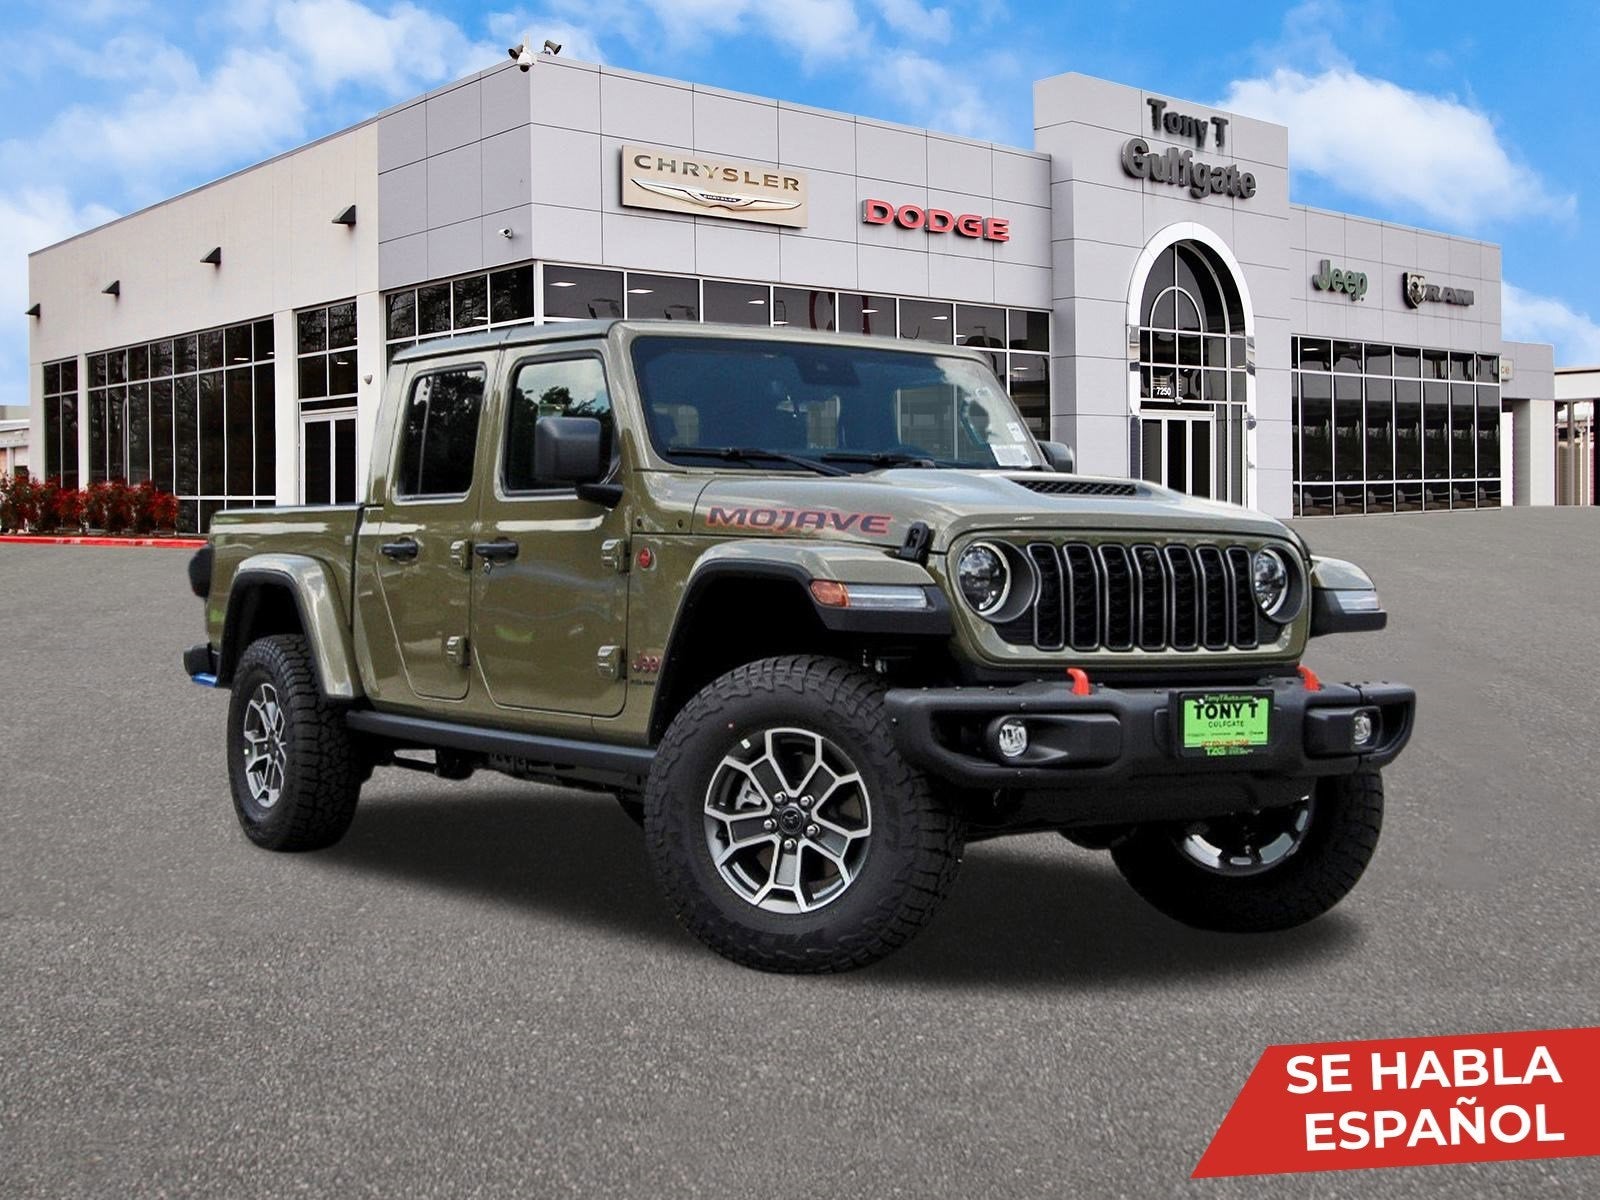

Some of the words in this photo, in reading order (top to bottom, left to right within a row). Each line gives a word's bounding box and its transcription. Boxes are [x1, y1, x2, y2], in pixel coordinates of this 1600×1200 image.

[1146, 98, 1207, 148] Tony
[1211, 117, 1229, 147] T
[634, 154, 800, 191] CHRYSLER
[1121, 138, 1256, 199] Gulfgate
[862, 198, 1010, 242] DODGE
[1313, 259, 1368, 302] Jeep
[1425, 284, 1474, 306] RAM
[1156, 387, 1171, 396] 7250
[707, 507, 893, 534] MOJAVE
[1194, 703, 1243, 720] TONY
[1248, 703, 1258, 718] T
